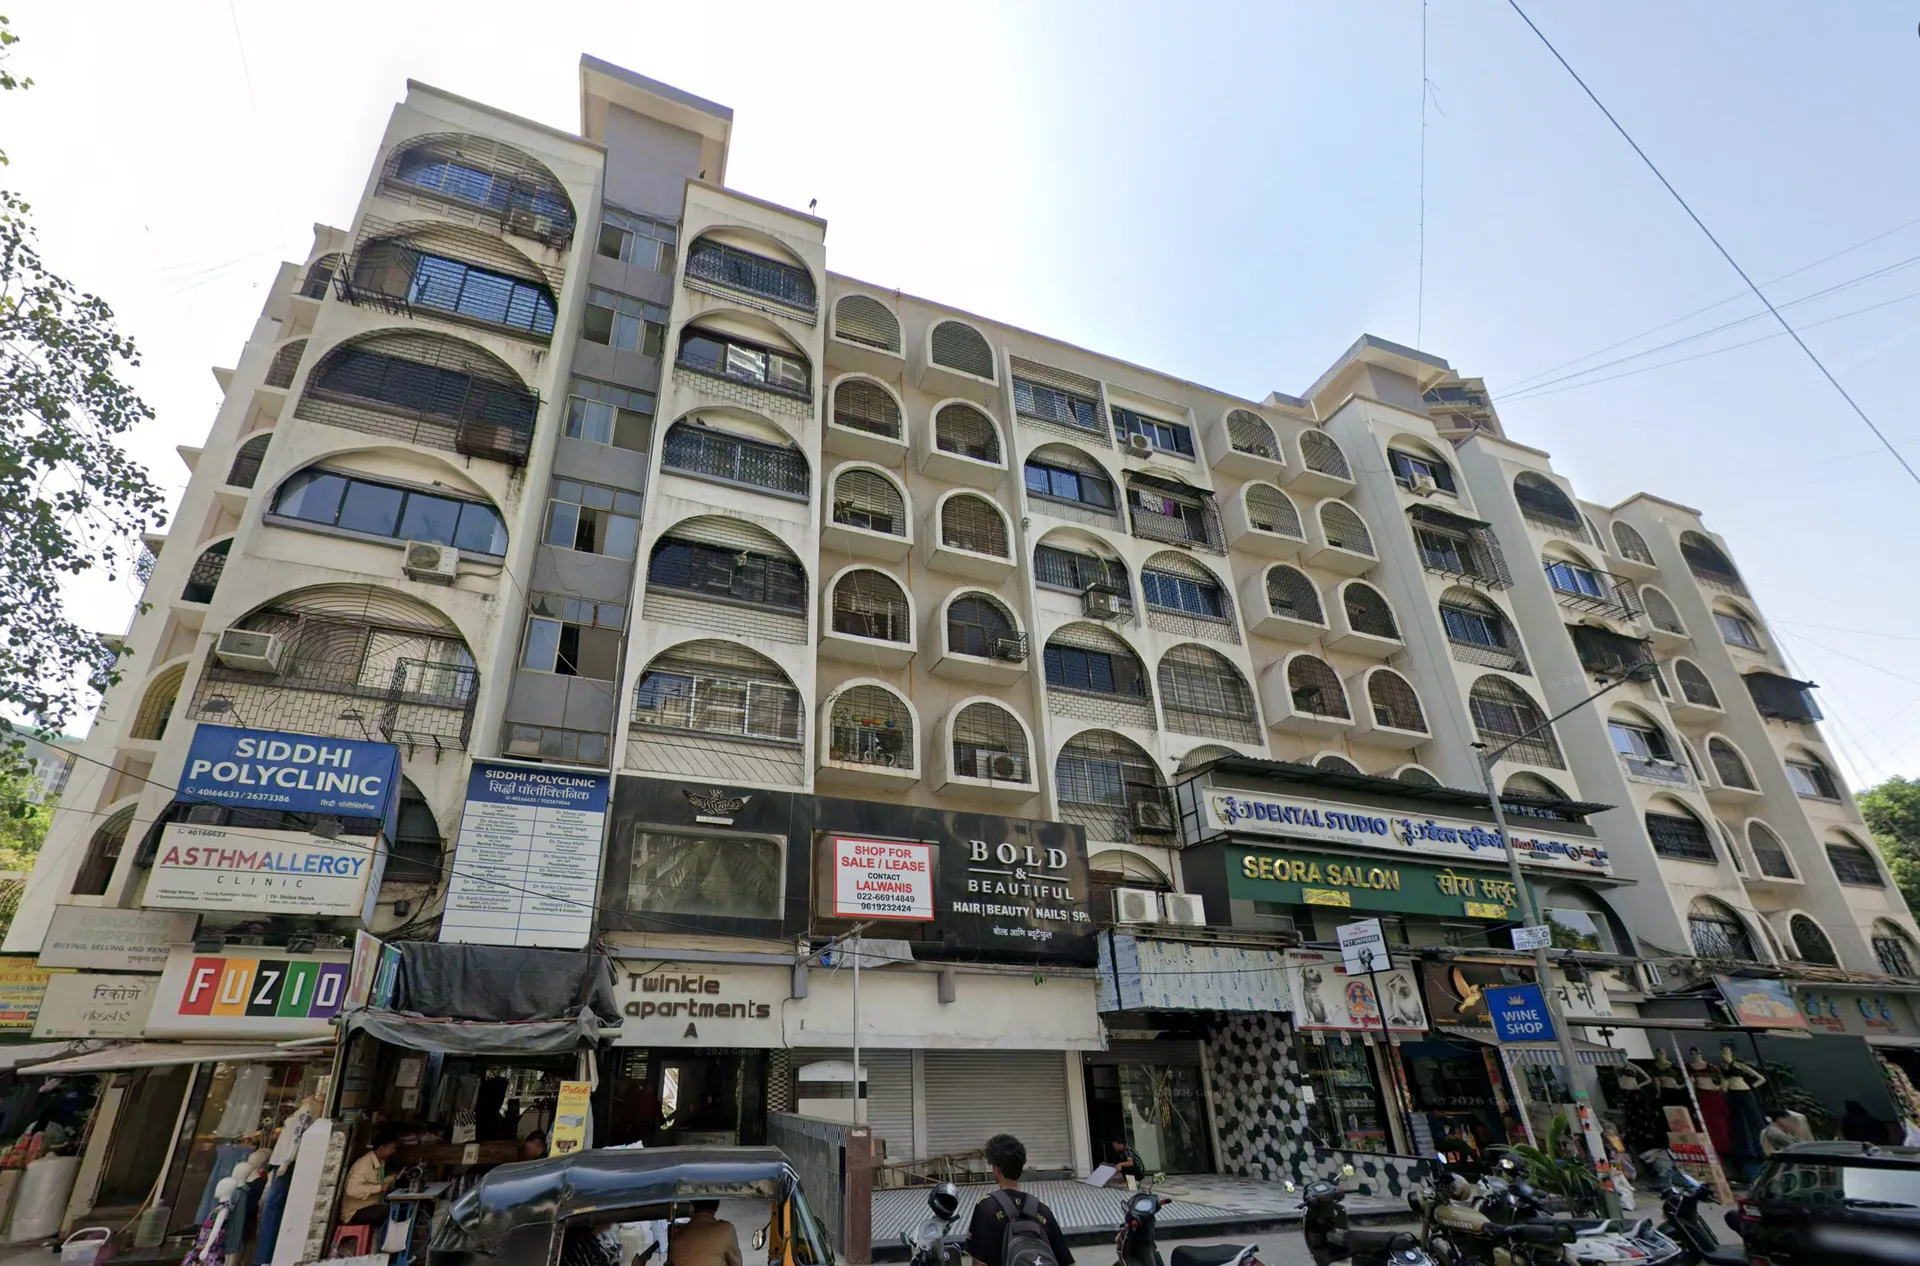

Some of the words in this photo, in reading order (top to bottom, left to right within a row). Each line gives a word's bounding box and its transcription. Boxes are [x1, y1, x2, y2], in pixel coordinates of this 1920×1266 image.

[235, 737, 353, 769] SIDDHI
[189, 759, 382, 796] POLYCLINIC
[485, 769, 527, 781] SIDDHI
[529, 773, 596, 788] POLYCLINIC
[197, 788, 239, 799] 40166633
[246, 791, 290, 803] 26373386
[489, 779, 517, 795] सिद्धी
[518, 783, 590, 800] पॉलीक्लिनिक
[1254, 801, 1326, 829] DENTAL
[1325, 810, 1389, 836] STUDIO
[161, 845, 367, 876] ASTHMALLERGY
[854, 845, 886, 856] SHOP
[888, 848, 912, 859] FOR
[969, 839, 1068, 869] BOLD
[841, 856, 875, 869] SALE
[877, 858, 882, 869] /
[885, 859, 926, 872] LEASE
[1241, 855, 1325, 884] SEORA
[1325, 863, 1401, 891] SALON
[216, 875, 303, 889] CLINIC
[867, 872, 901, 881] CONTACT
[1015, 867, 1027, 880] &
[1433, 867, 1476, 897] सोरा
[856, 880, 913, 893] LALWANIS
[967, 879, 1075, 900] BEAUTIFUL
[856, 892, 915, 903] 022-66914849
[860, 902, 912, 912] 9619232424
[953, 901, 982, 915] HAIR
[986, 903, 1030, 917] BEAUTY
[1036, 909, 1067, 921] NAILS
[1072, 910, 1091, 923] SPA
[1010, 926, 1026, 938] आणि
[1344, 939, 1354, 947] PET
[1353, 935, 1379, 945] UNIVERSE
[93, 983, 142, 1001] रिकोशे
[188, 968, 342, 1007] FUZIO
[627, 971, 721, 995] Twinkle
[624, 998, 771, 1020] apartments
[1501, 1009, 1540, 1022] WINE
[683, 1021, 699, 1039] A
[1506, 1021, 1544, 1035] SHOP
